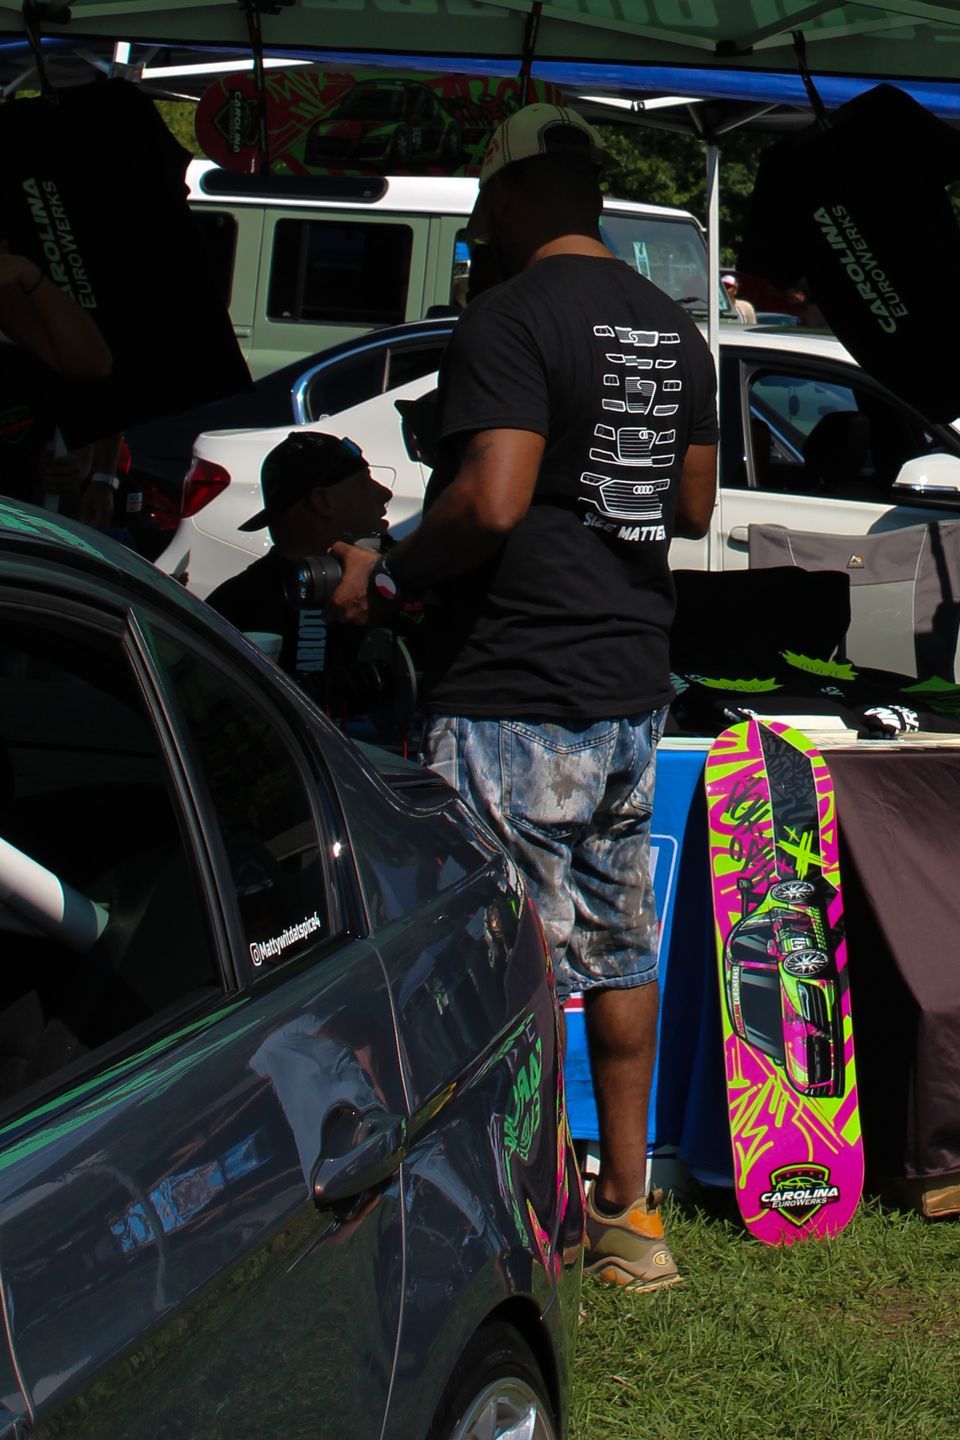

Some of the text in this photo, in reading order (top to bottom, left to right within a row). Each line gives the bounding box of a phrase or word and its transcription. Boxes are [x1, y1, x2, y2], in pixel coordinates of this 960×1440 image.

[22, 176, 78, 304] AROLINA
[813, 206, 897, 334] CAROLINA
[831, 204, 910, 318] EUROWERKS
[760, 1185, 839, 1203] CAROLINA
